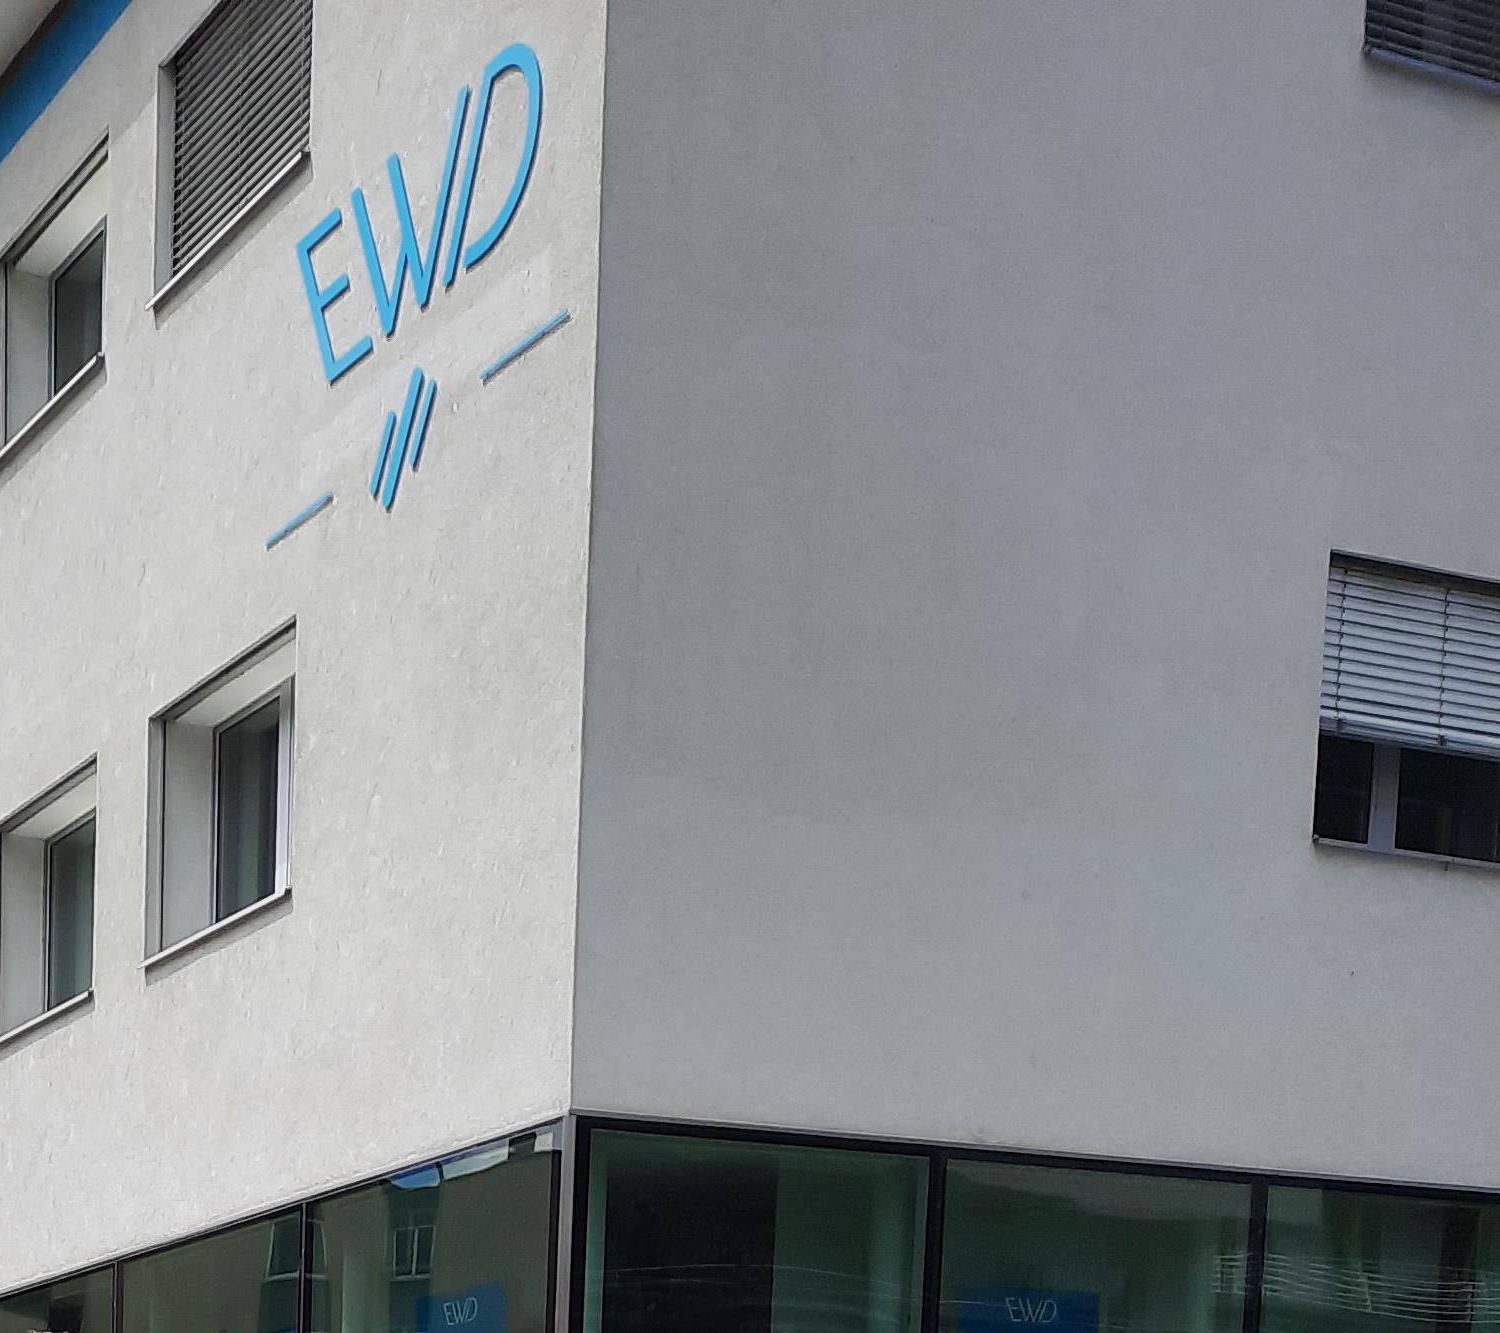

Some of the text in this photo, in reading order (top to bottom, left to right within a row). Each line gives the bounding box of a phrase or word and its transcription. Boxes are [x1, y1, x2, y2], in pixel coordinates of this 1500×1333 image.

[296, 42, 542, 384] EWD
[443, 1296, 478, 1326] EWD
[1005, 1296, 1057, 1323] EWD
